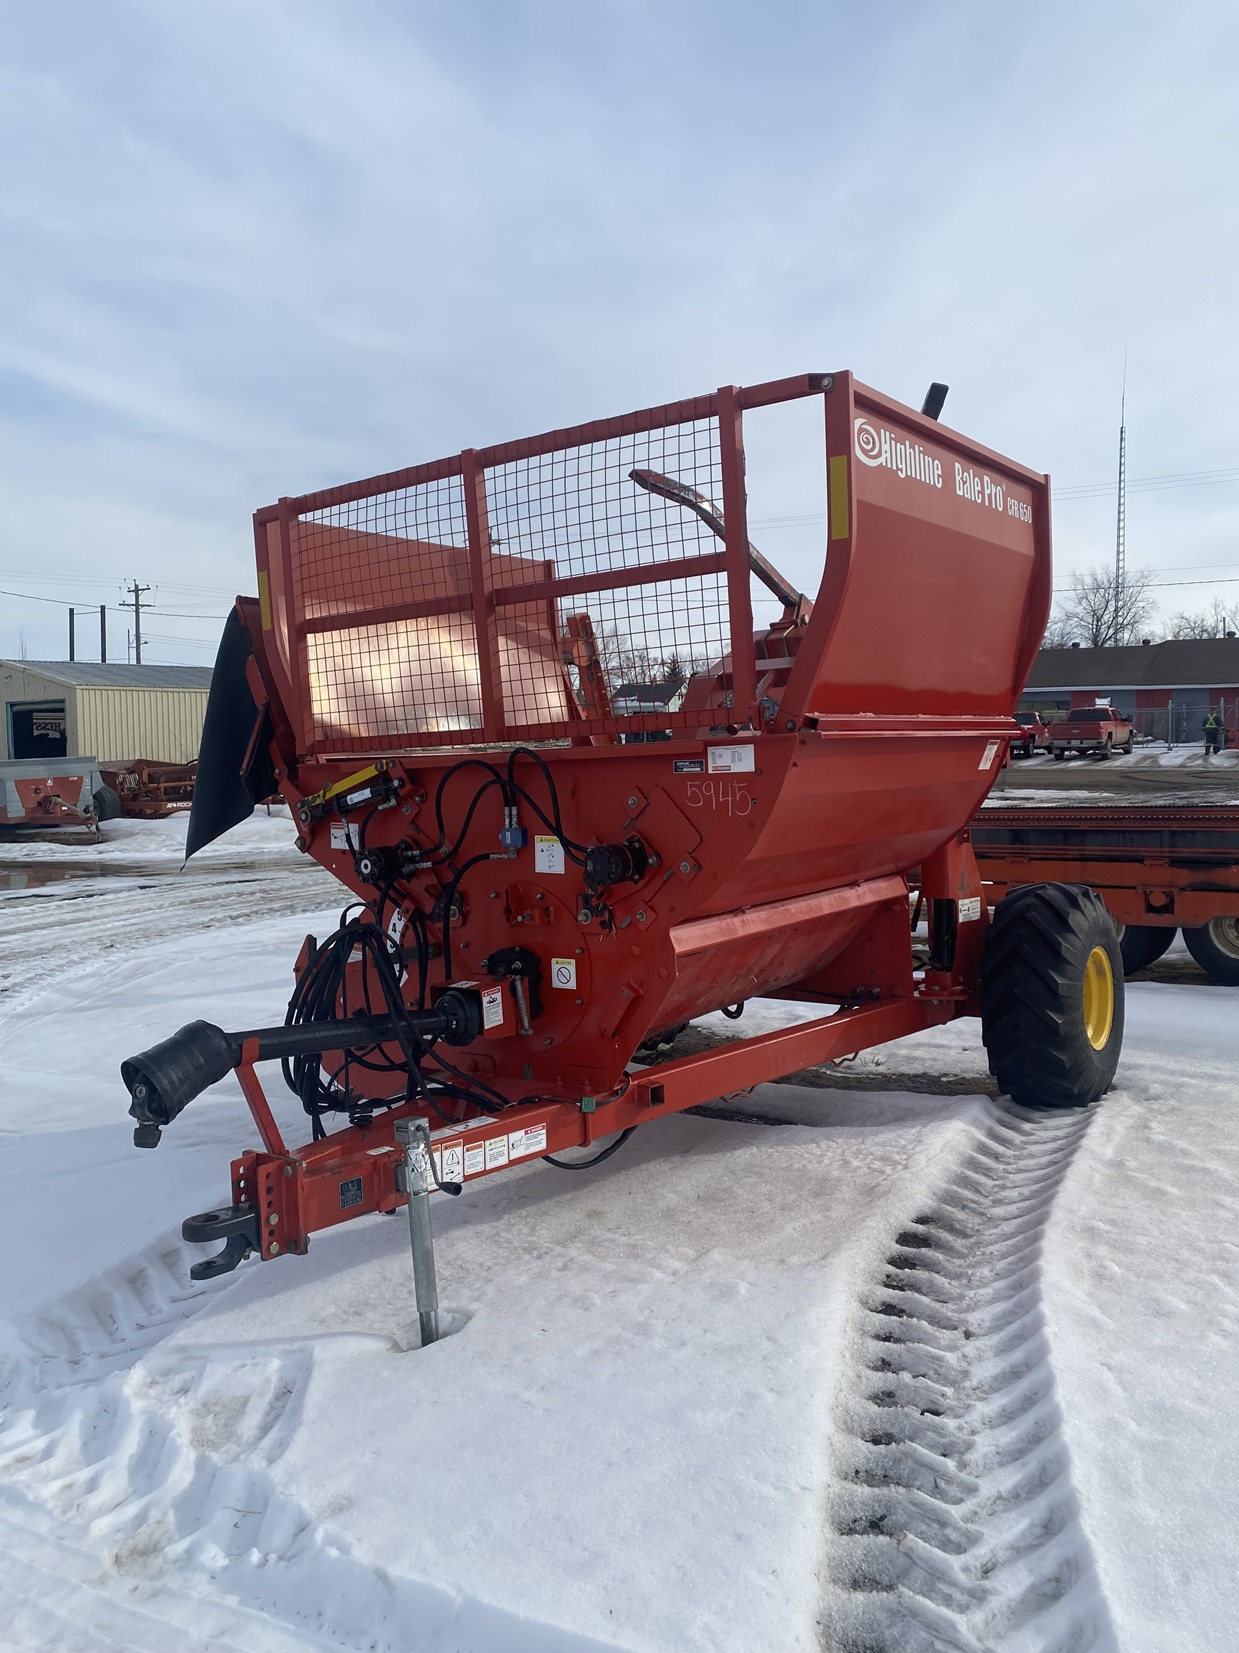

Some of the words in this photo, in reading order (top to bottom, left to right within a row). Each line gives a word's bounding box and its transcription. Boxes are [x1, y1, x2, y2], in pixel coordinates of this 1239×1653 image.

[880, 428, 943, 488] Highline
[954, 461, 982, 504] Bale
[1007, 497, 1019, 519] CFR
[1019, 502, 1032, 524] 650
[685, 780, 751, 817] 5945
[391, 922, 398, 934] 4
